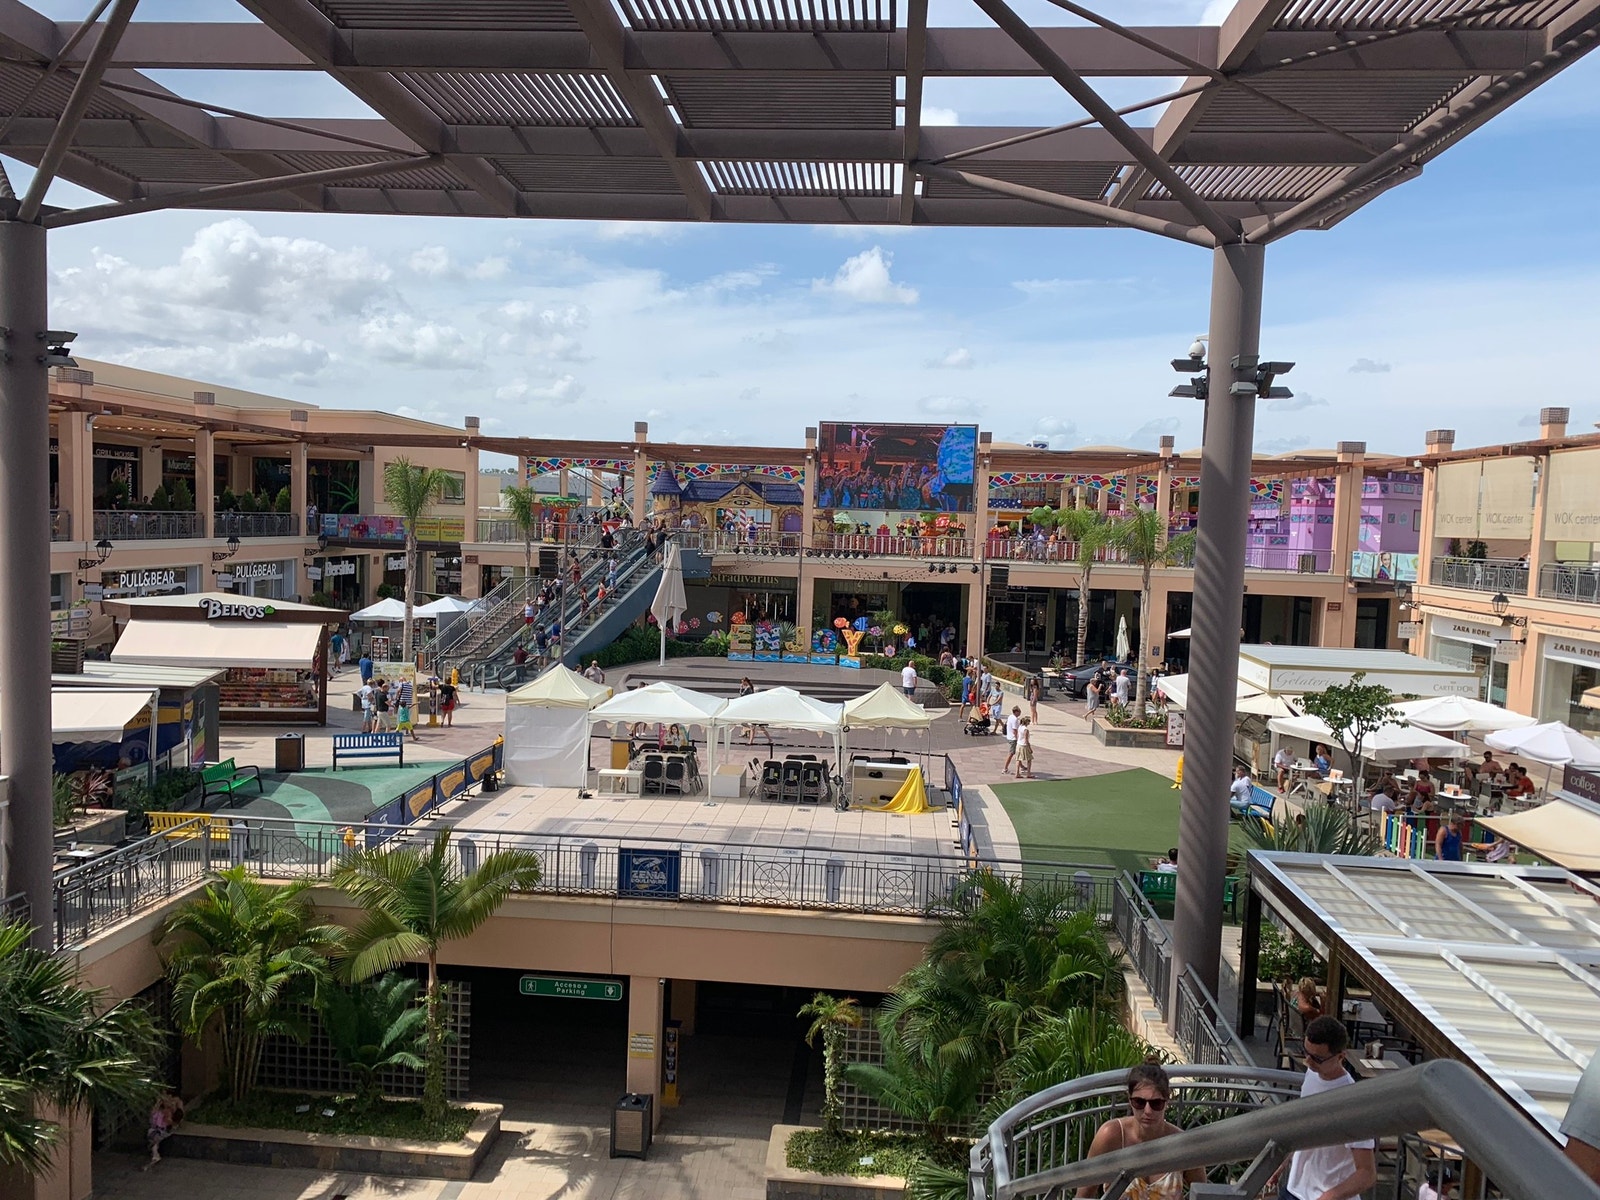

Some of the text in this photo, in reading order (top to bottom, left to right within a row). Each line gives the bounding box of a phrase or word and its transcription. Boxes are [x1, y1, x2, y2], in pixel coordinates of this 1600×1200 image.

[1440, 513, 1473, 524] WOK center
[1485, 512, 1524, 524] WOK center
[1554, 512, 1600, 525] WOK center
[235, 563, 277, 578] PULL&BEAR
[120, 570, 175, 588] PULL&BEAR
[1453, 624, 1491, 638] ZARA HOME
[1553, 642, 1600, 658] ZARA HOM
[1433, 683, 1456, 693] CARTE
[554, 981, 582, 989] Acceso
[556, 987, 585, 996] Parking
